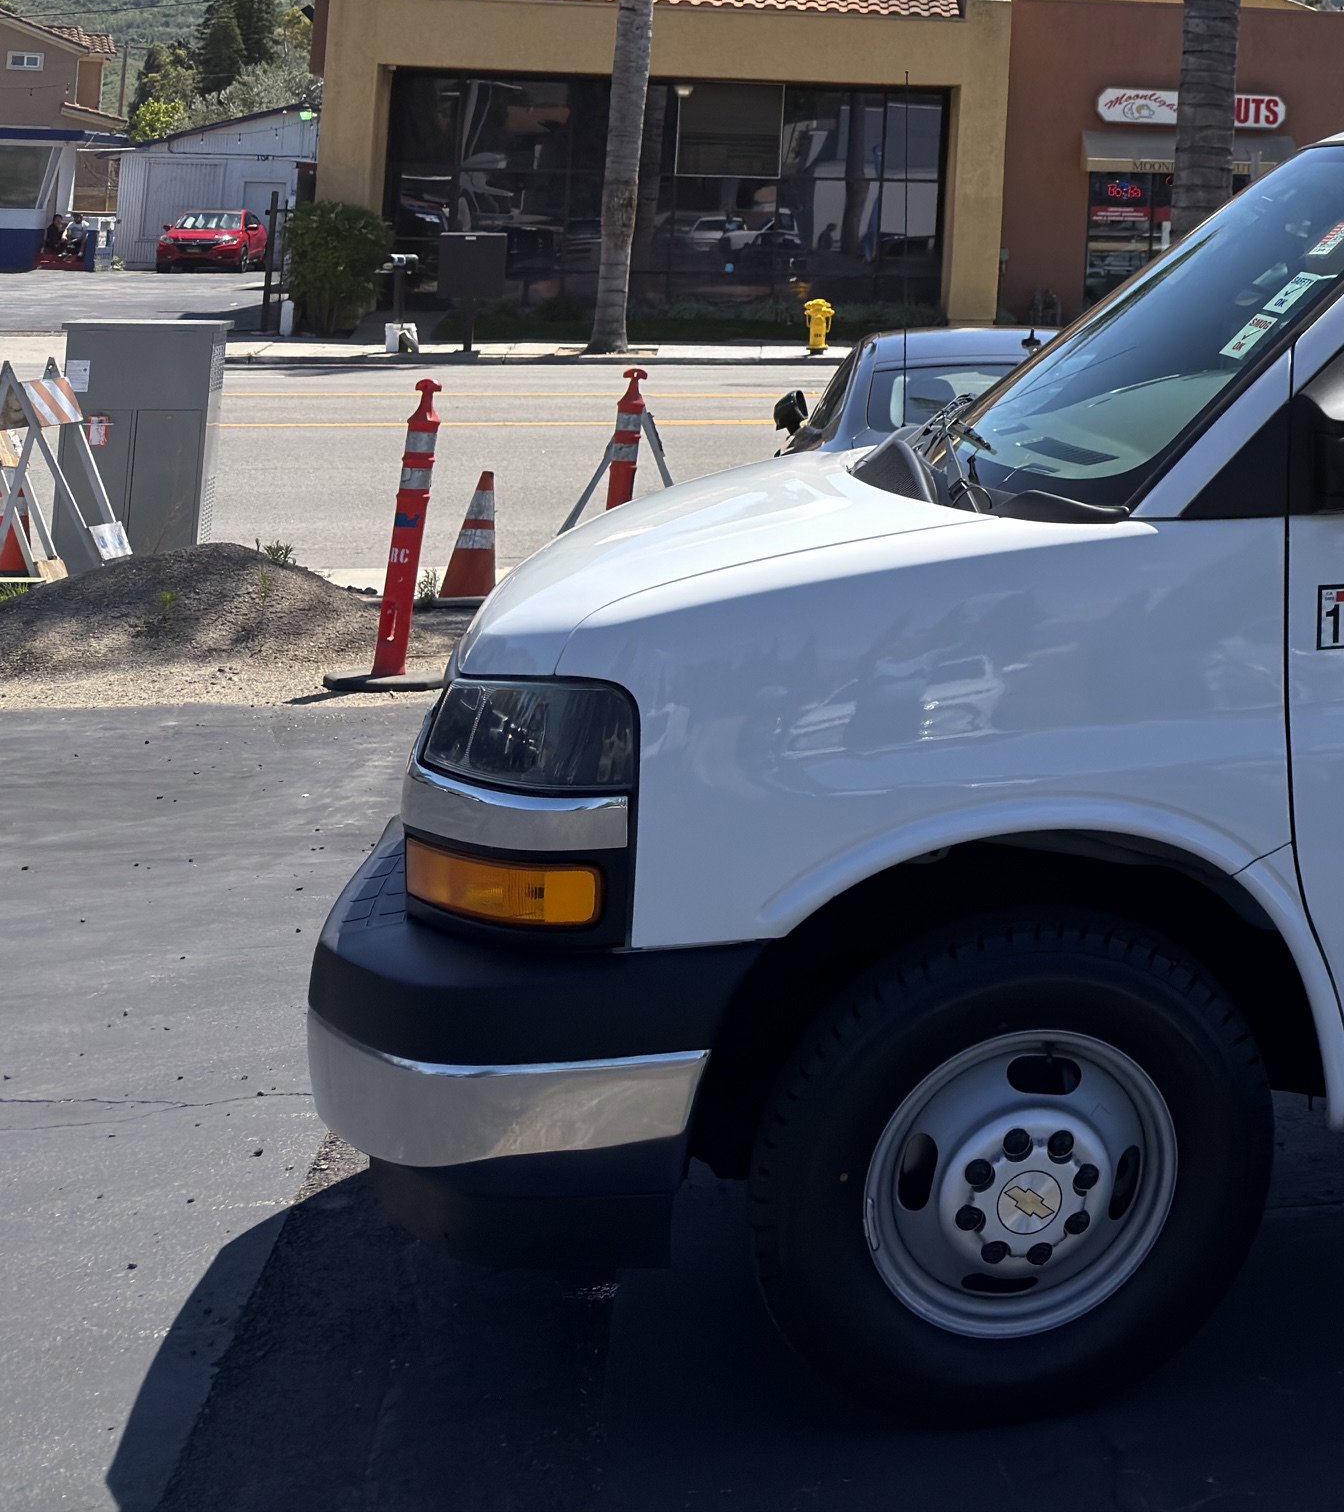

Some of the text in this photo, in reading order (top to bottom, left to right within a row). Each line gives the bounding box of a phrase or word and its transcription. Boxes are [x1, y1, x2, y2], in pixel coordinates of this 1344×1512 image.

[1104, 92, 1279, 125] Moonligh UTS
[1290, 276, 1315, 287] SAFETY
[1274, 298, 1288, 308] OK
[1250, 318, 1273, 330] SMOG
[1232, 341, 1246, 351] OK
